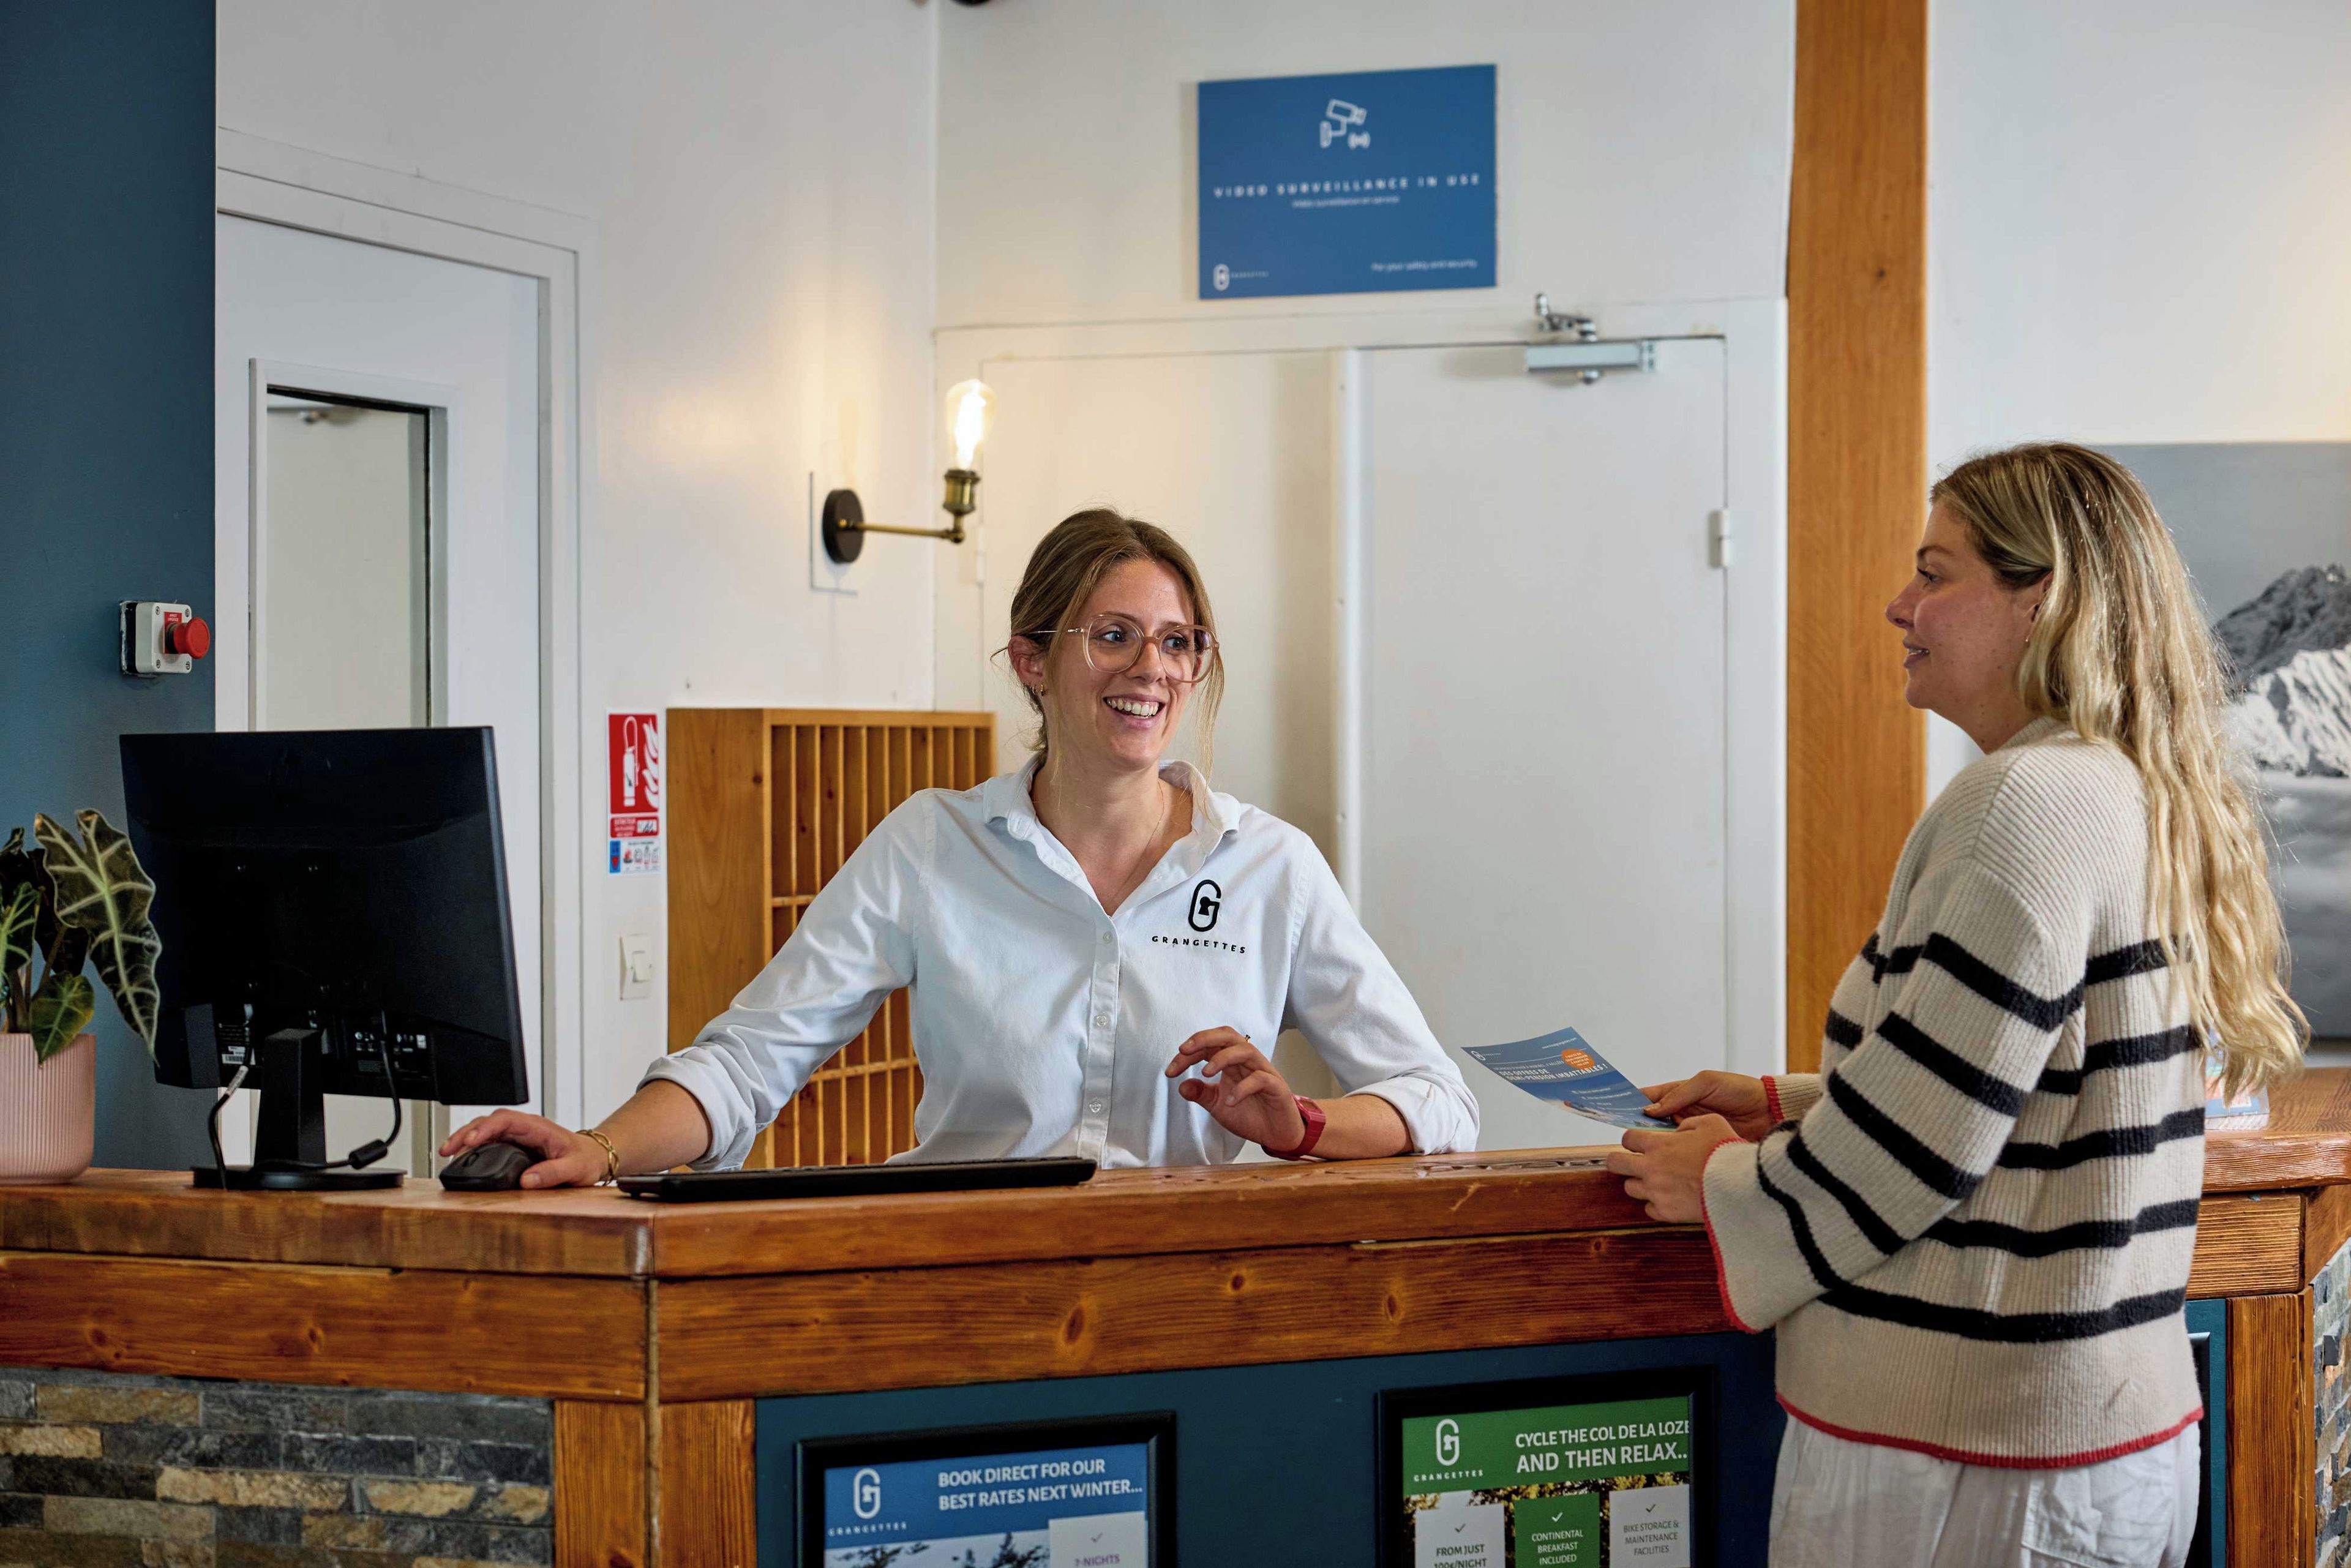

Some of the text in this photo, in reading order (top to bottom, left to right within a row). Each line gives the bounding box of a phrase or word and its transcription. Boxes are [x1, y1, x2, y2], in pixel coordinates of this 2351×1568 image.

[1213, 173, 1480, 198] VIDEO SURVEILLANCE IN USE
[1152, 936, 1246, 954] GRANGETTES
[1557, 1064, 1604, 1078] IMBATTABLES
[1515, 1431, 1558, 1448] CYCLE
[1559, 1428, 1588, 1444] THE
[1589, 1426, 1616, 1441] COL
[1618, 1424, 1637, 1439] DE
[1640, 1423, 1656, 1438] LA
[1517, 1452, 1559, 1473] AND
[1565, 1447, 1616, 1469] THEN
[938, 1458, 1106, 1488] BOOK DIRECT FOR OUR
[1414, 1469, 1483, 1482] GRANGETTES
[939, 1479, 1143, 1510] BEST RATES NEXT WINTER...
[827, 1521, 906, 1537] GRANGETTES
[1623, 1519, 1679, 1533] BIKE STORAGE &
[1532, 1529, 1583, 1542] CONTINENTAL
[1625, 1532, 1678, 1544] MAINTENANCE
[1436, 1544, 1485, 1556] FROM JUST
[1537, 1542, 1578, 1553] BREAKFAST
[1633, 1544, 1670, 1556] FACILITIES
[1539, 1554, 1577, 1565] INCLUDED
